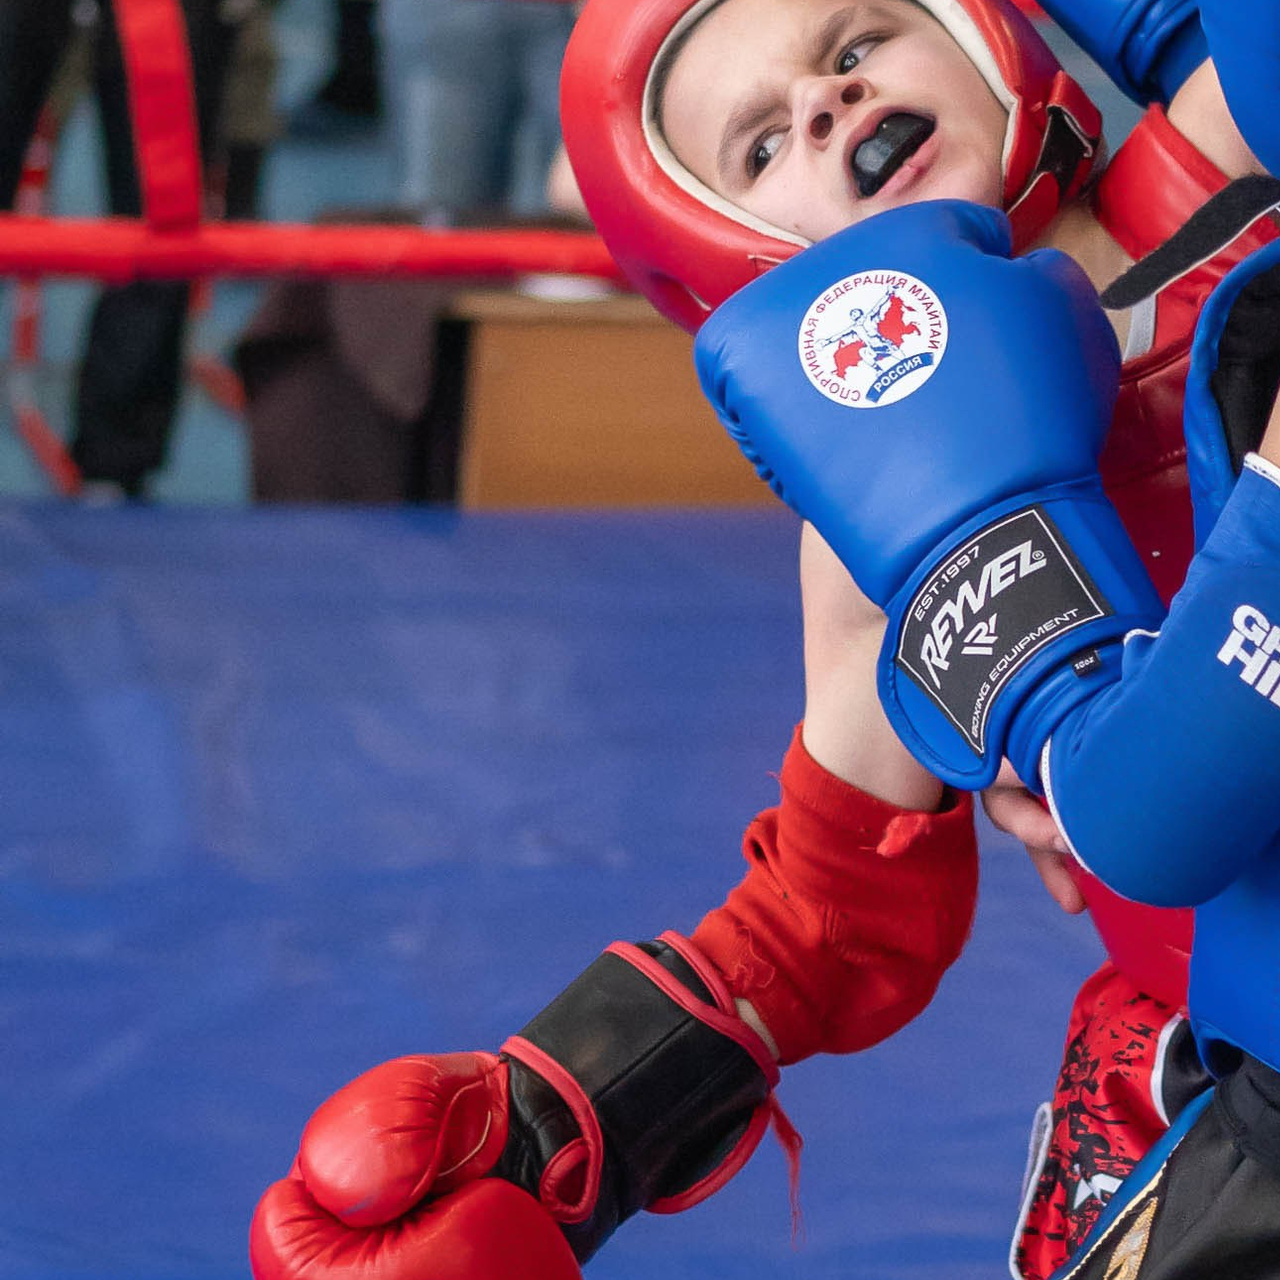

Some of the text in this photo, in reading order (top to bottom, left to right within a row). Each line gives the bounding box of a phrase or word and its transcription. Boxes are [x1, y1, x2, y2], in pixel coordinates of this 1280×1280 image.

[803, 274, 943, 402] СПОРТИВНАЯ ФЕДЕРАЦИЯ МУАЙТАЙ
[873, 356, 922, 393] РОССИЯ
[914, 545, 981, 622] EST.1997
[971, 608, 1079, 739] BOXING EQUIPMENT
